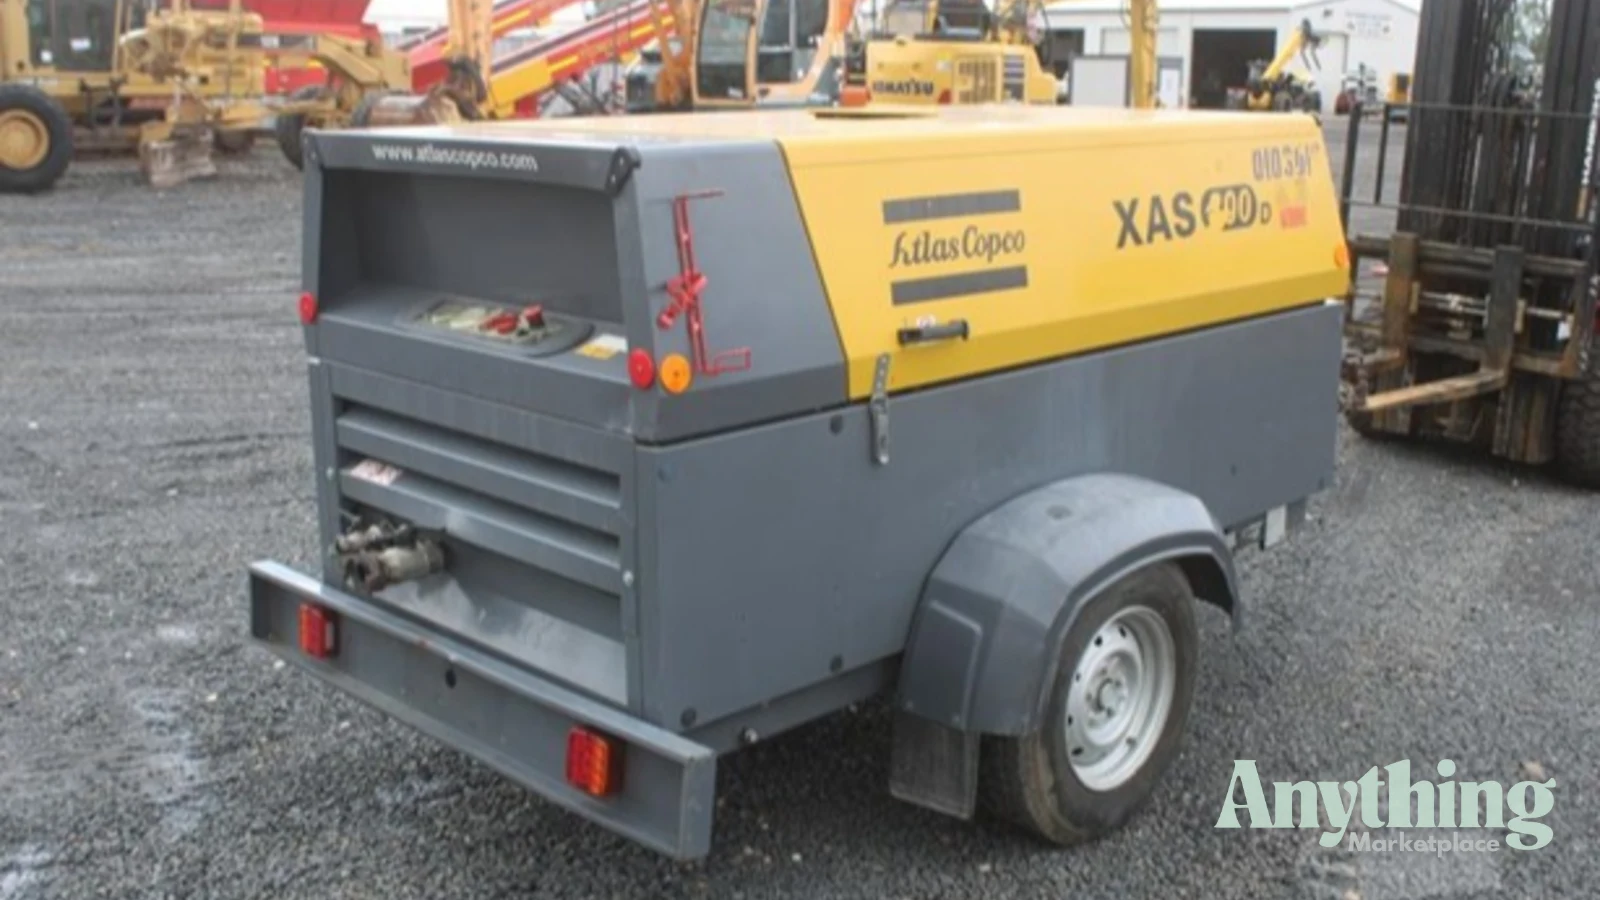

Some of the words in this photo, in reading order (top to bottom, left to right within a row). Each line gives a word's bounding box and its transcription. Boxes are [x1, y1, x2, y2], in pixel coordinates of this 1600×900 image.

[371, 143, 538, 172] www.atlascopco.com
[1112, 190, 1196, 249] XAS
[888, 229, 960, 269] Atlas
[962, 223, 1026, 263] Copco
